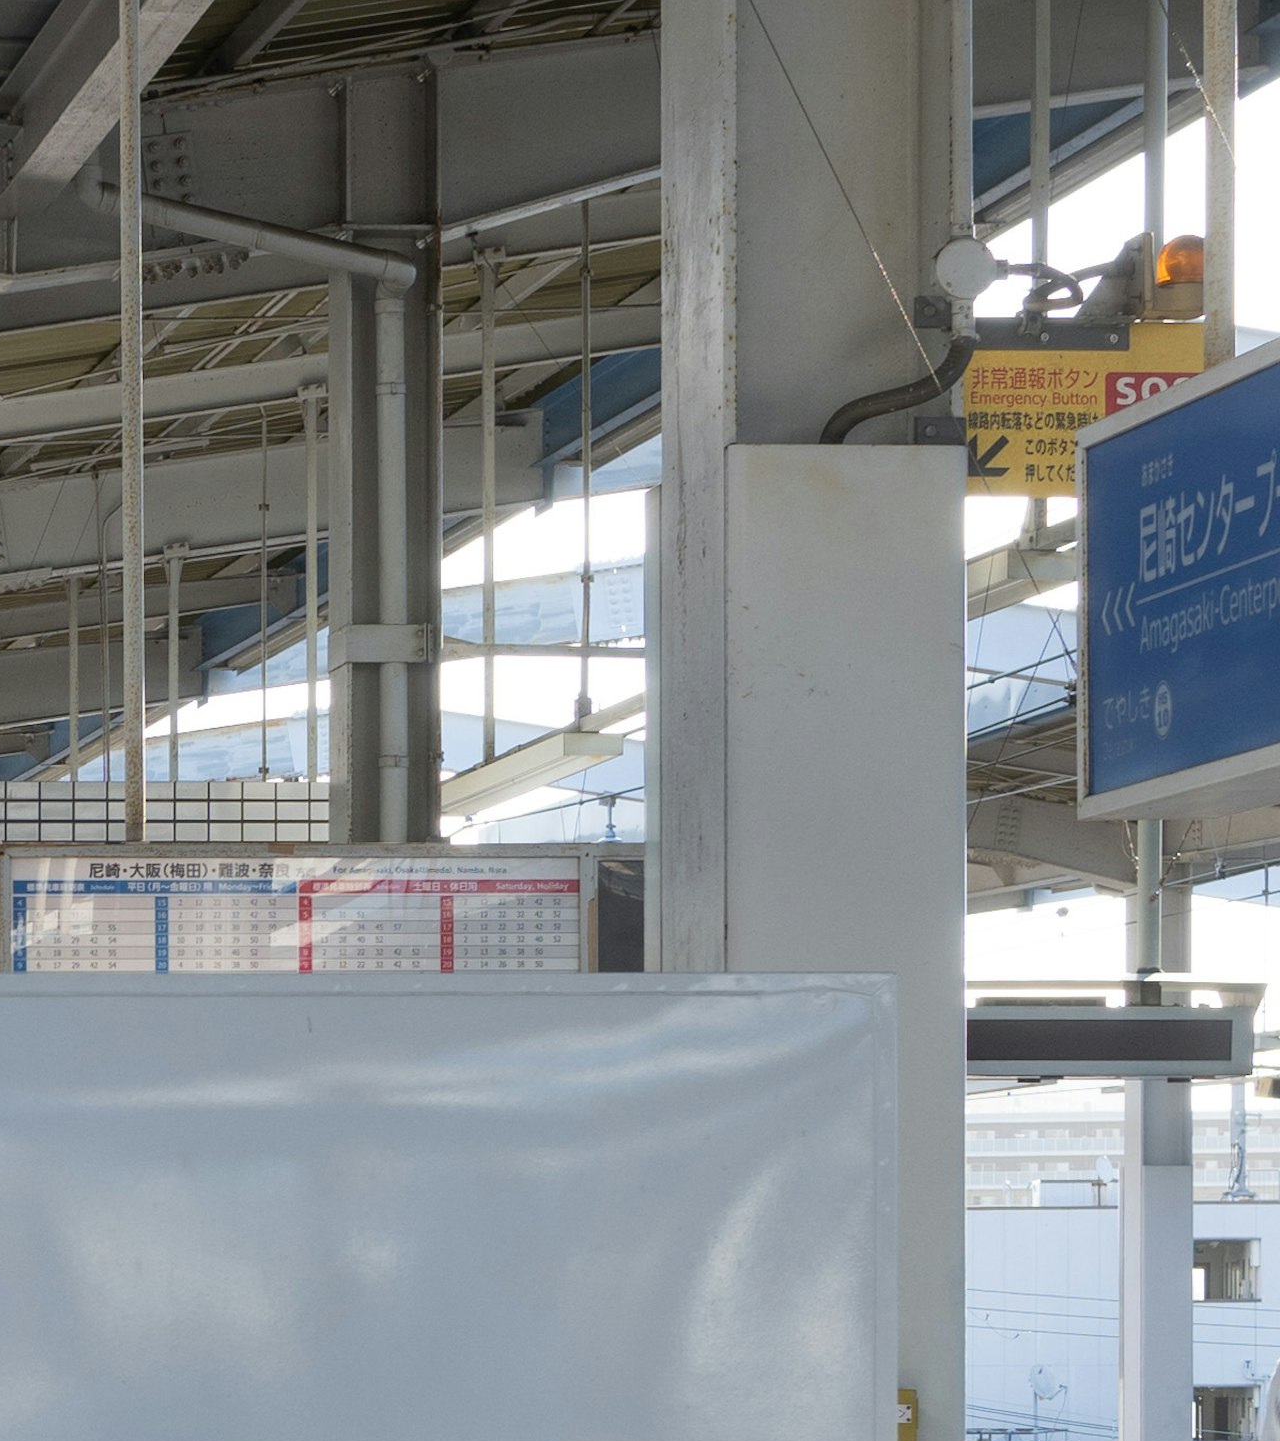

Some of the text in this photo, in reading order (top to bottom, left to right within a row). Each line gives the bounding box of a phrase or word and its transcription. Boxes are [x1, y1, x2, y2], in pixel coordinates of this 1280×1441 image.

[971, 367, 1099, 390] 非常通報ボタン
[1116, 376, 1192, 407] SO
[970, 391, 1097, 408] Emergency Button
[1139, 448, 1280, 584] 尼崎センタープ
[1141, 577, 1280, 654] Amagasaki-Centerp
